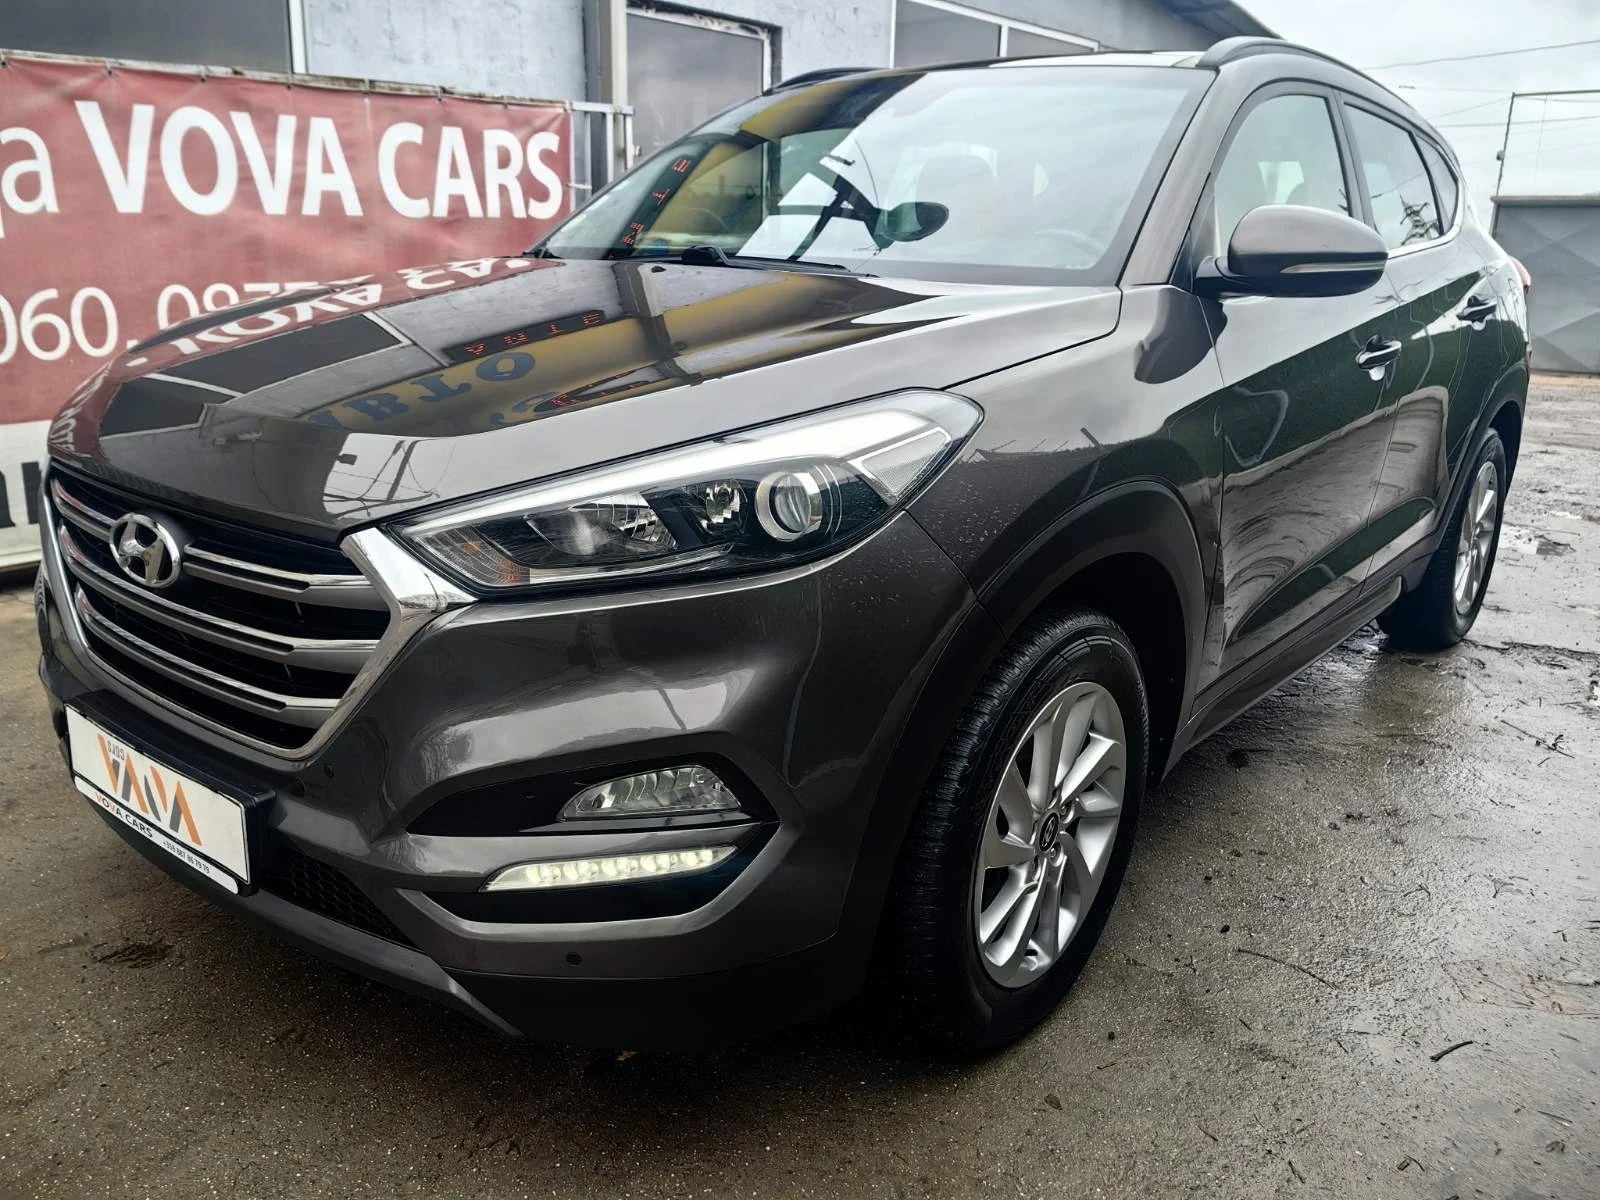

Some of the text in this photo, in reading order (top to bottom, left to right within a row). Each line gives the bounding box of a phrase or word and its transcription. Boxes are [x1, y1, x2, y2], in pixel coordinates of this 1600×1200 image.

[74, 100, 363, 217] VOVA
[378, 121, 563, 220] CARS
[94, 791, 153, 838] VOVA CARS
